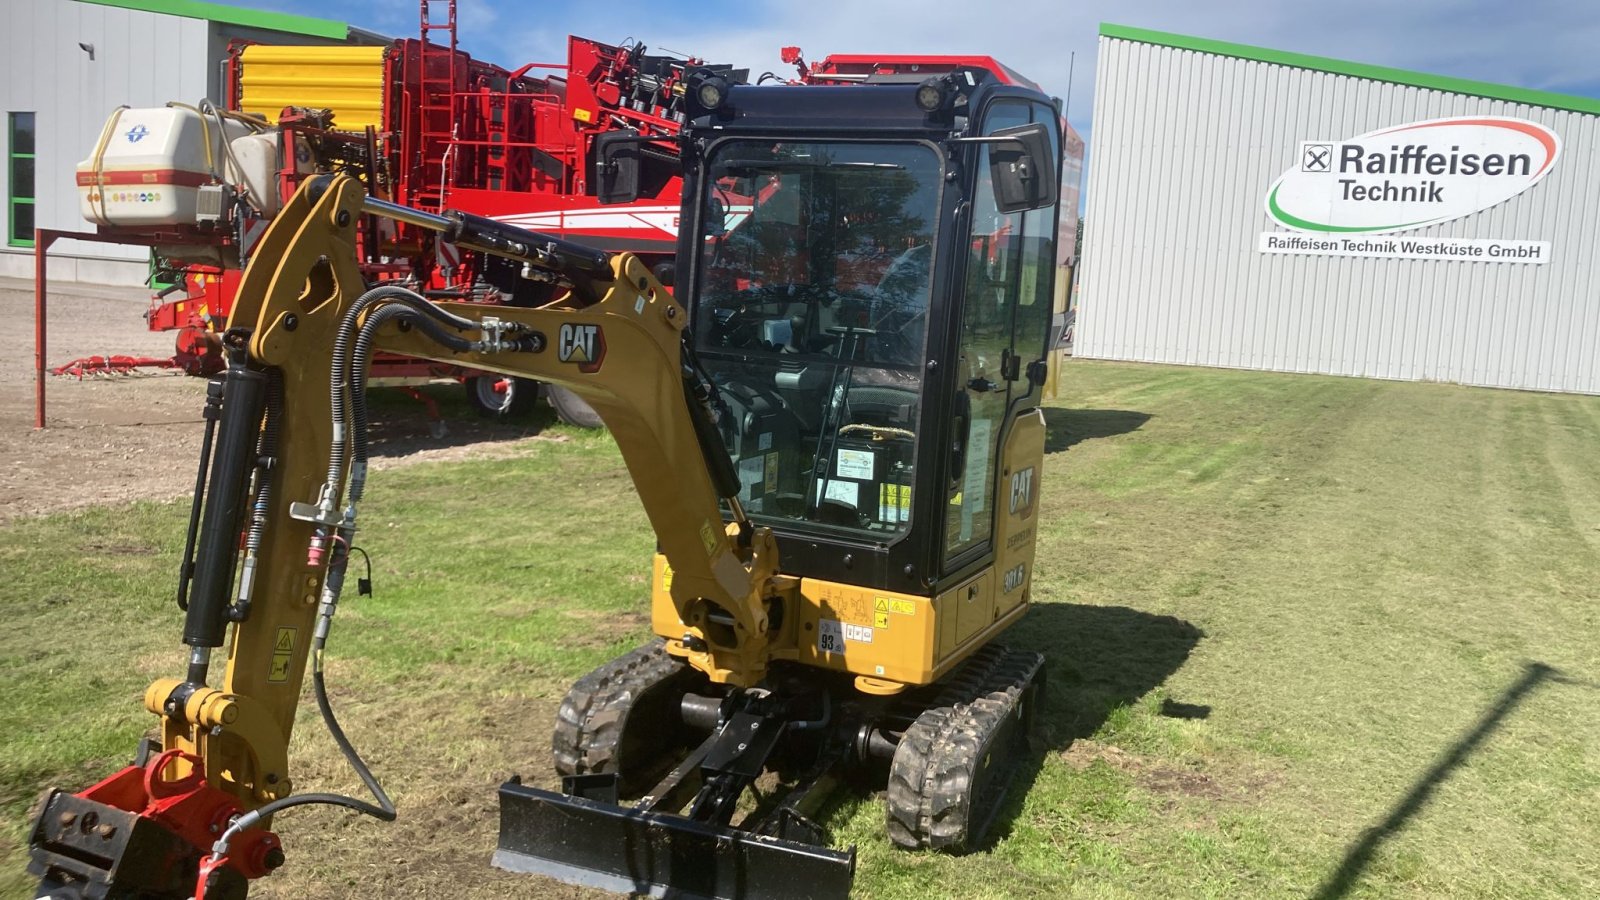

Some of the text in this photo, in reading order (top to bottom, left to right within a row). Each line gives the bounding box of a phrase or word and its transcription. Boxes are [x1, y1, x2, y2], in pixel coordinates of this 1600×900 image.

[1339, 144, 1531, 176] Raiffeisen
[1338, 179, 1444, 203] Technik
[1268, 236, 1541, 258] Raiffeisen Technik Westküste GmbH
[560, 324, 597, 362] CAT
[1010, 467, 1034, 514] CAT
[821, 634, 834, 650] 93
